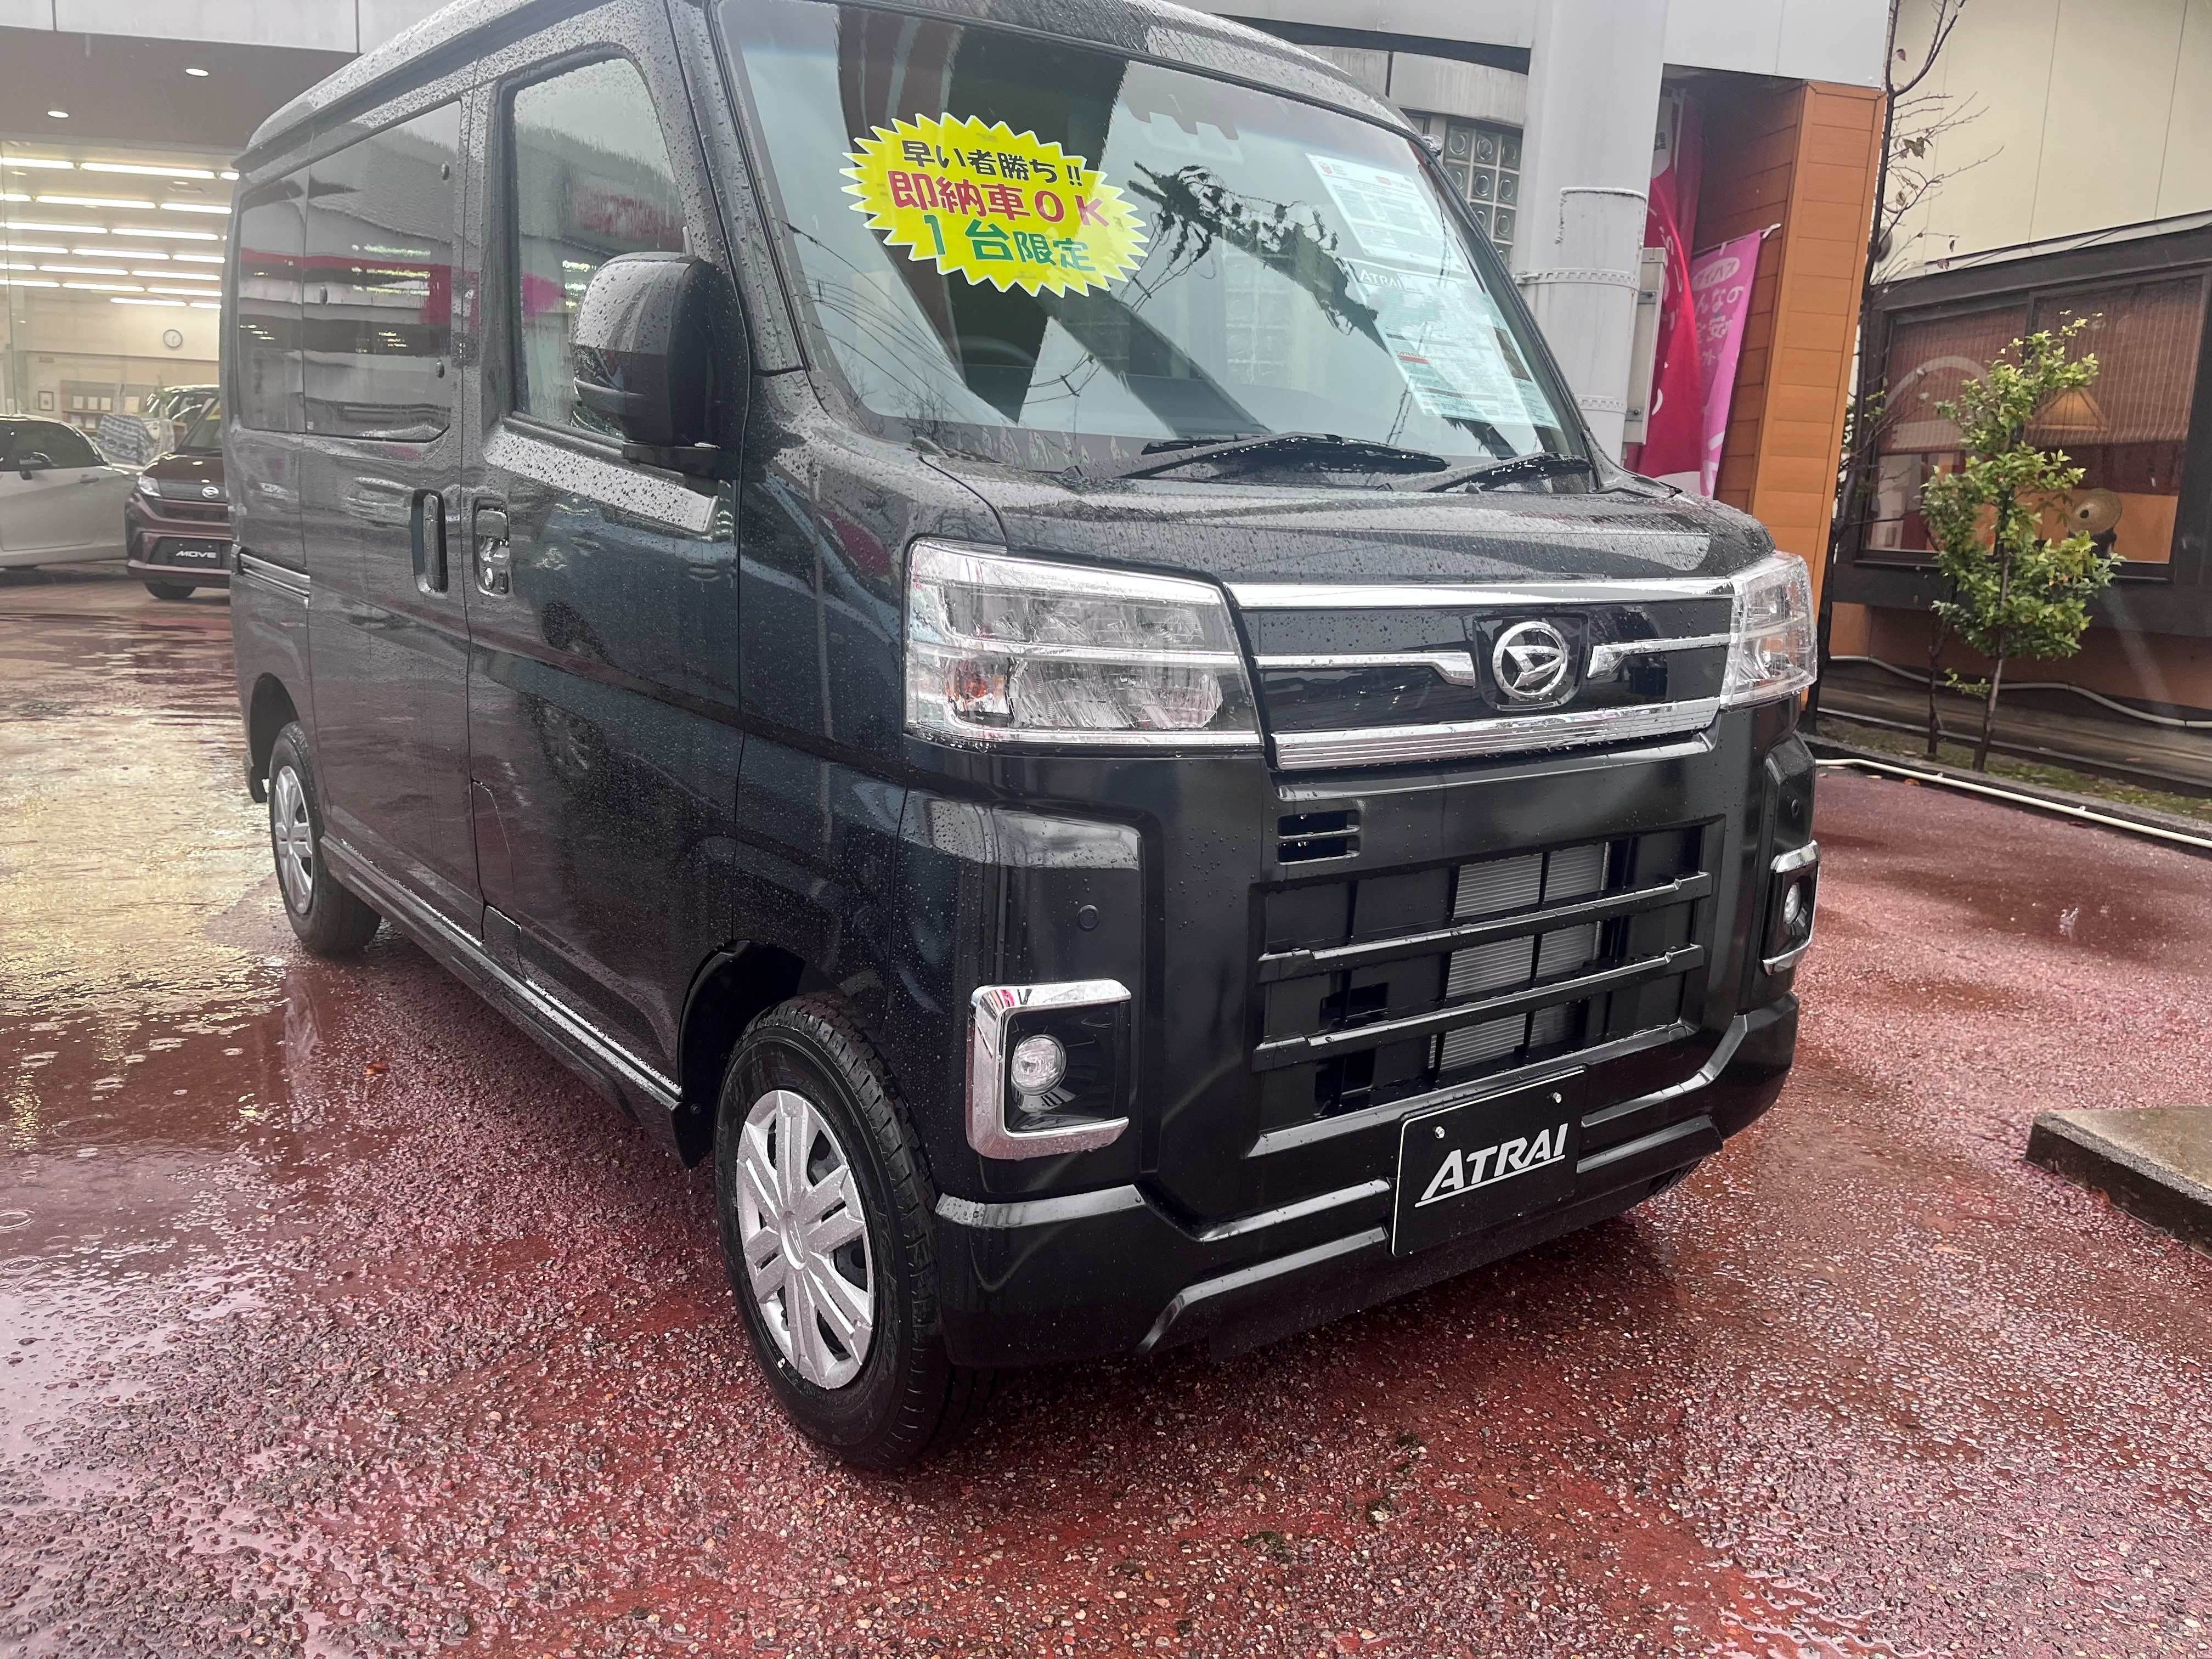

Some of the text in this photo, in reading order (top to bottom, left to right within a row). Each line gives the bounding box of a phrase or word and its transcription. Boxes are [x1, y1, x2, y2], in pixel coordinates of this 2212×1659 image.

[902, 139, 1082, 187] 早い者勝ち!!
[887, 171, 1110, 228] 即納車OK
[923, 215, 1097, 272] 1台限定
[1359, 269, 1402, 289] ATRAI
[175, 550, 217, 558] MOVE
[1420, 1122, 1568, 1201] ATRAI
